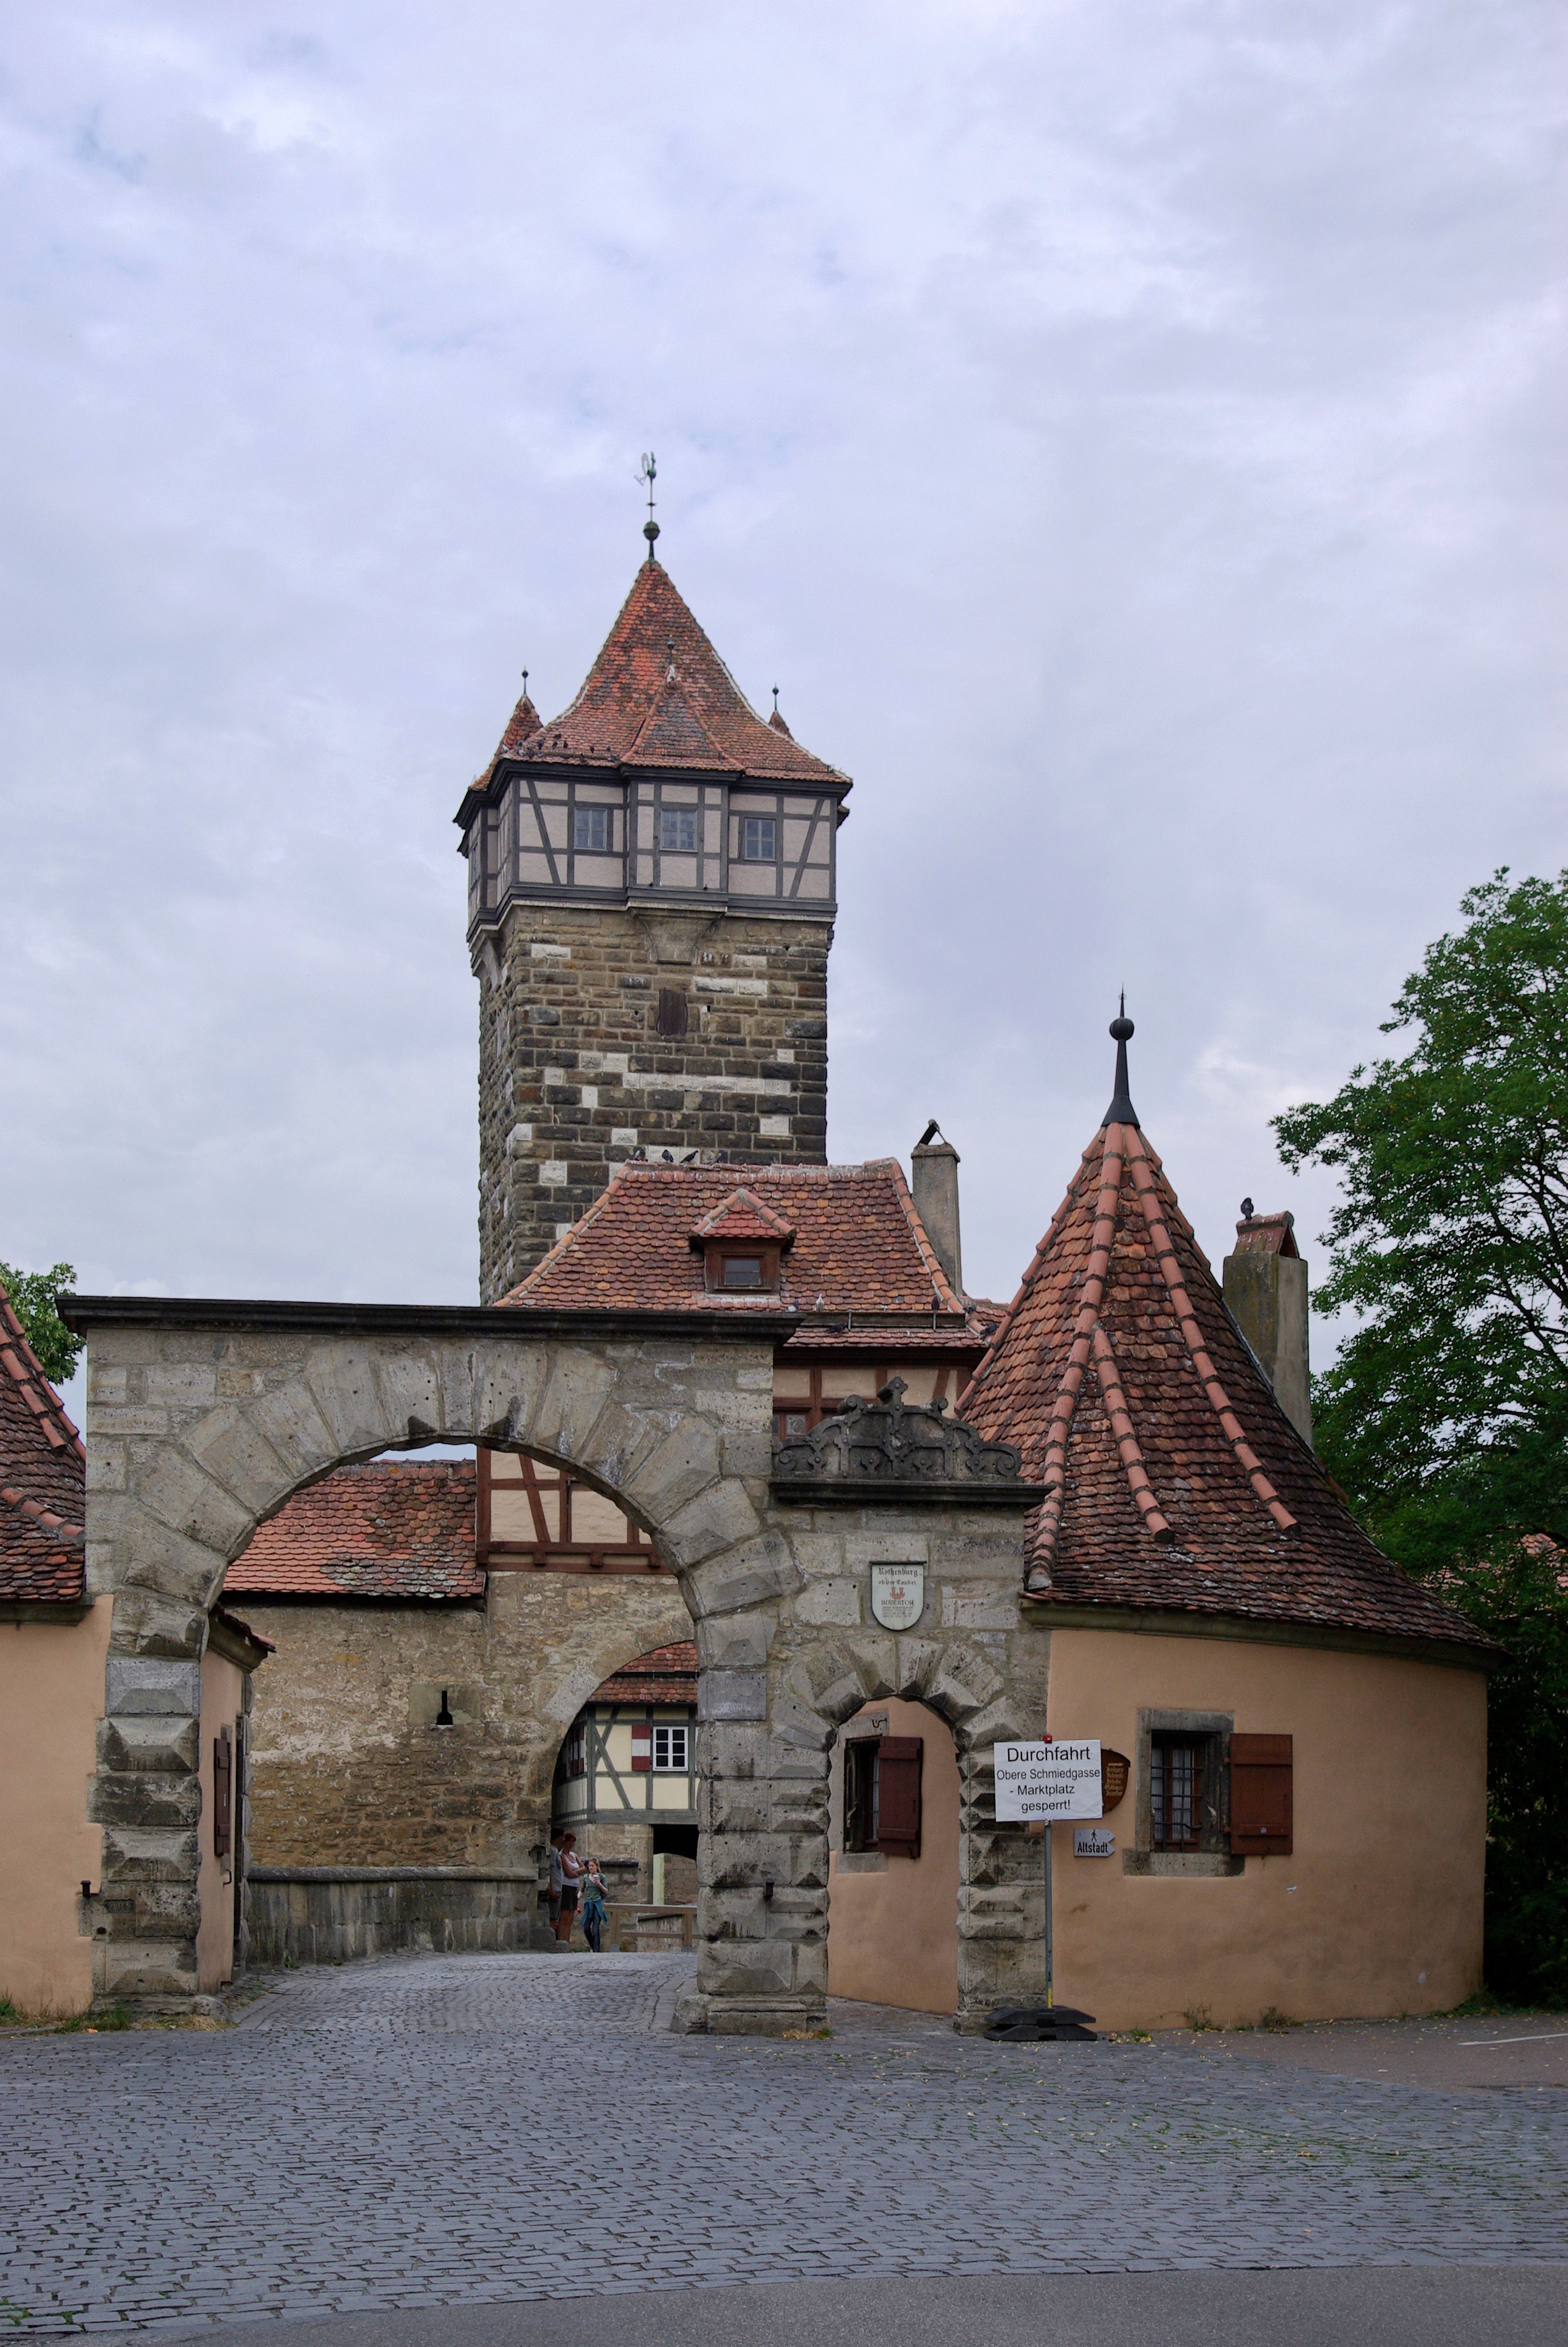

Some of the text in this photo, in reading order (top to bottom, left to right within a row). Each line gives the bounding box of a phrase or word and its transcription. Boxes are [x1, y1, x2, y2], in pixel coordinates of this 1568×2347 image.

[878, 1567, 918, 1577] Rothenburg
[1007, 1746, 1091, 1762] Durchfahrt
[997, 1769, 1027, 1780] Obere
[1030, 1768, 1101, 1781] Schmiedgasse
[1017, 1784, 1075, 1797] Marktplatz
[1022, 1799, 1071, 1813] gesperrt!
[1077, 1841, 1108, 1853] Altstadt
